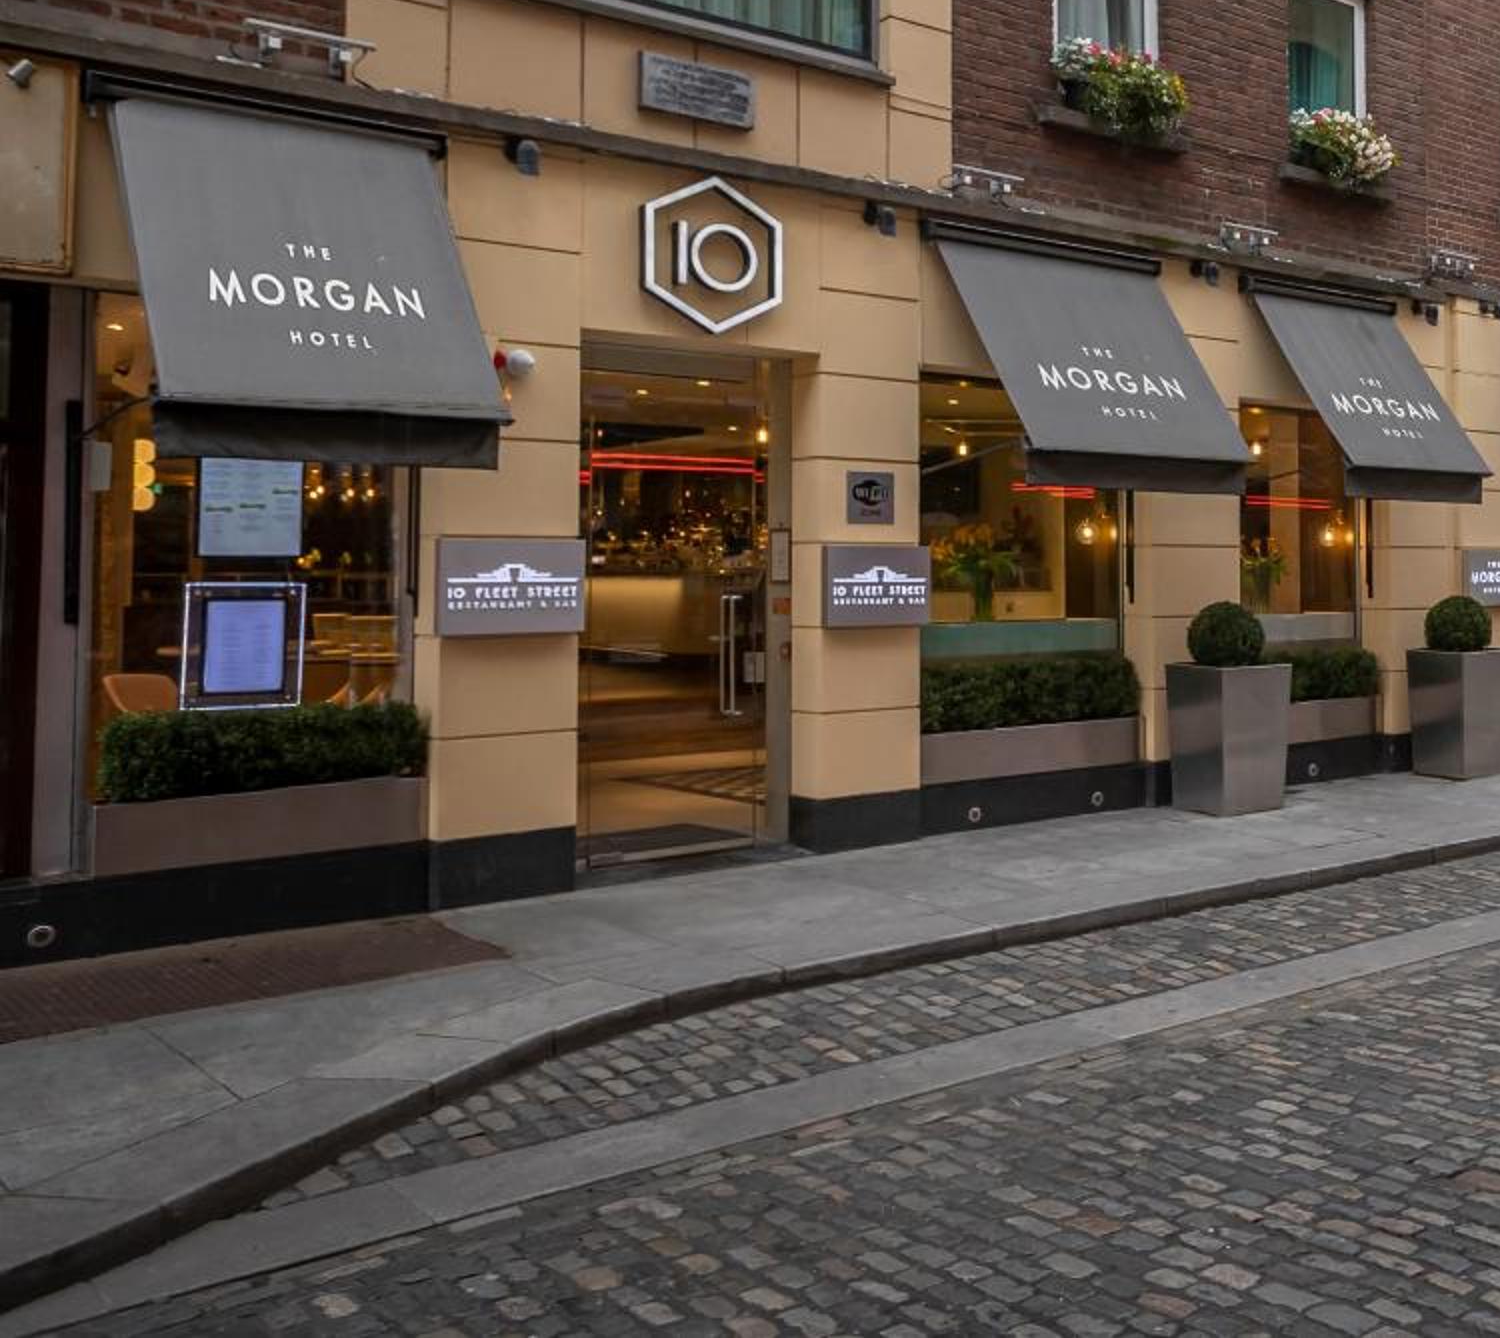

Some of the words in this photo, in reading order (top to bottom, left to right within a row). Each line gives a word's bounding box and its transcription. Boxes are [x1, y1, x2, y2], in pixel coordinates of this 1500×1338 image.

[285, 242, 332, 262] THE
[208, 266, 426, 320] MORGAN
[289, 329, 373, 350] HOTEL
[1080, 345, 1114, 360] THE
[1036, 362, 1188, 402] MORGAN
[1101, 404, 1160, 421] HOTEL
[1330, 392, 1441, 422] MORGAN
[475, 585, 518, 600] FLEET
[527, 584, 578, 599] STREET
[853, 584, 885, 597] FLEET
[888, 584, 927, 596] STREET
